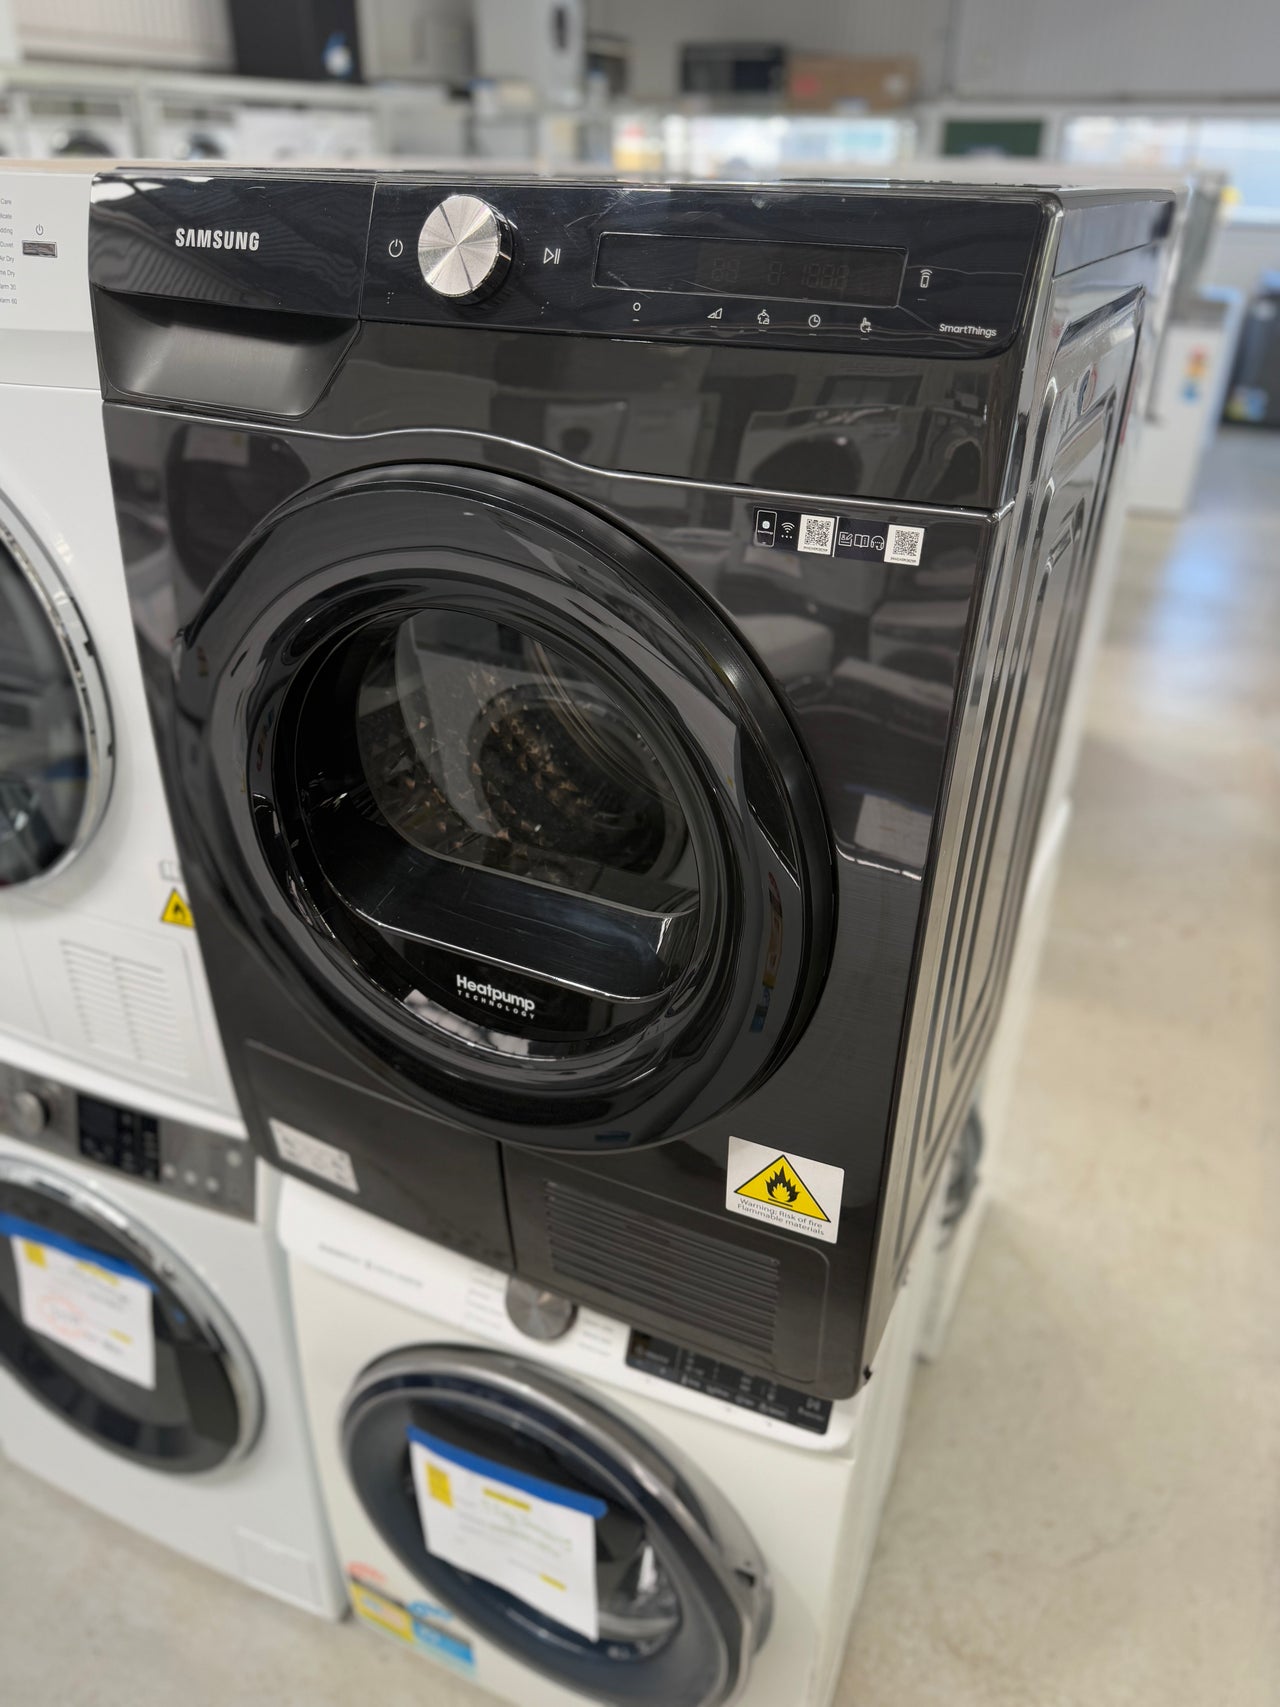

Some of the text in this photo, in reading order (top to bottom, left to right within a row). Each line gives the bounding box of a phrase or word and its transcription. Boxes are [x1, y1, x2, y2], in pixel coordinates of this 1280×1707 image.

[175, 227, 260, 251] SAMSUNG
[939, 323, 998, 339] SmartThings
[456, 974, 536, 1012] Heatpump
[457, 989, 535, 1020] TECHNOLOGY
[737, 1203, 824, 1235] Flammable materials
[779, 1210, 796, 1221] Risk
[808, 1220, 823, 1229] fire
